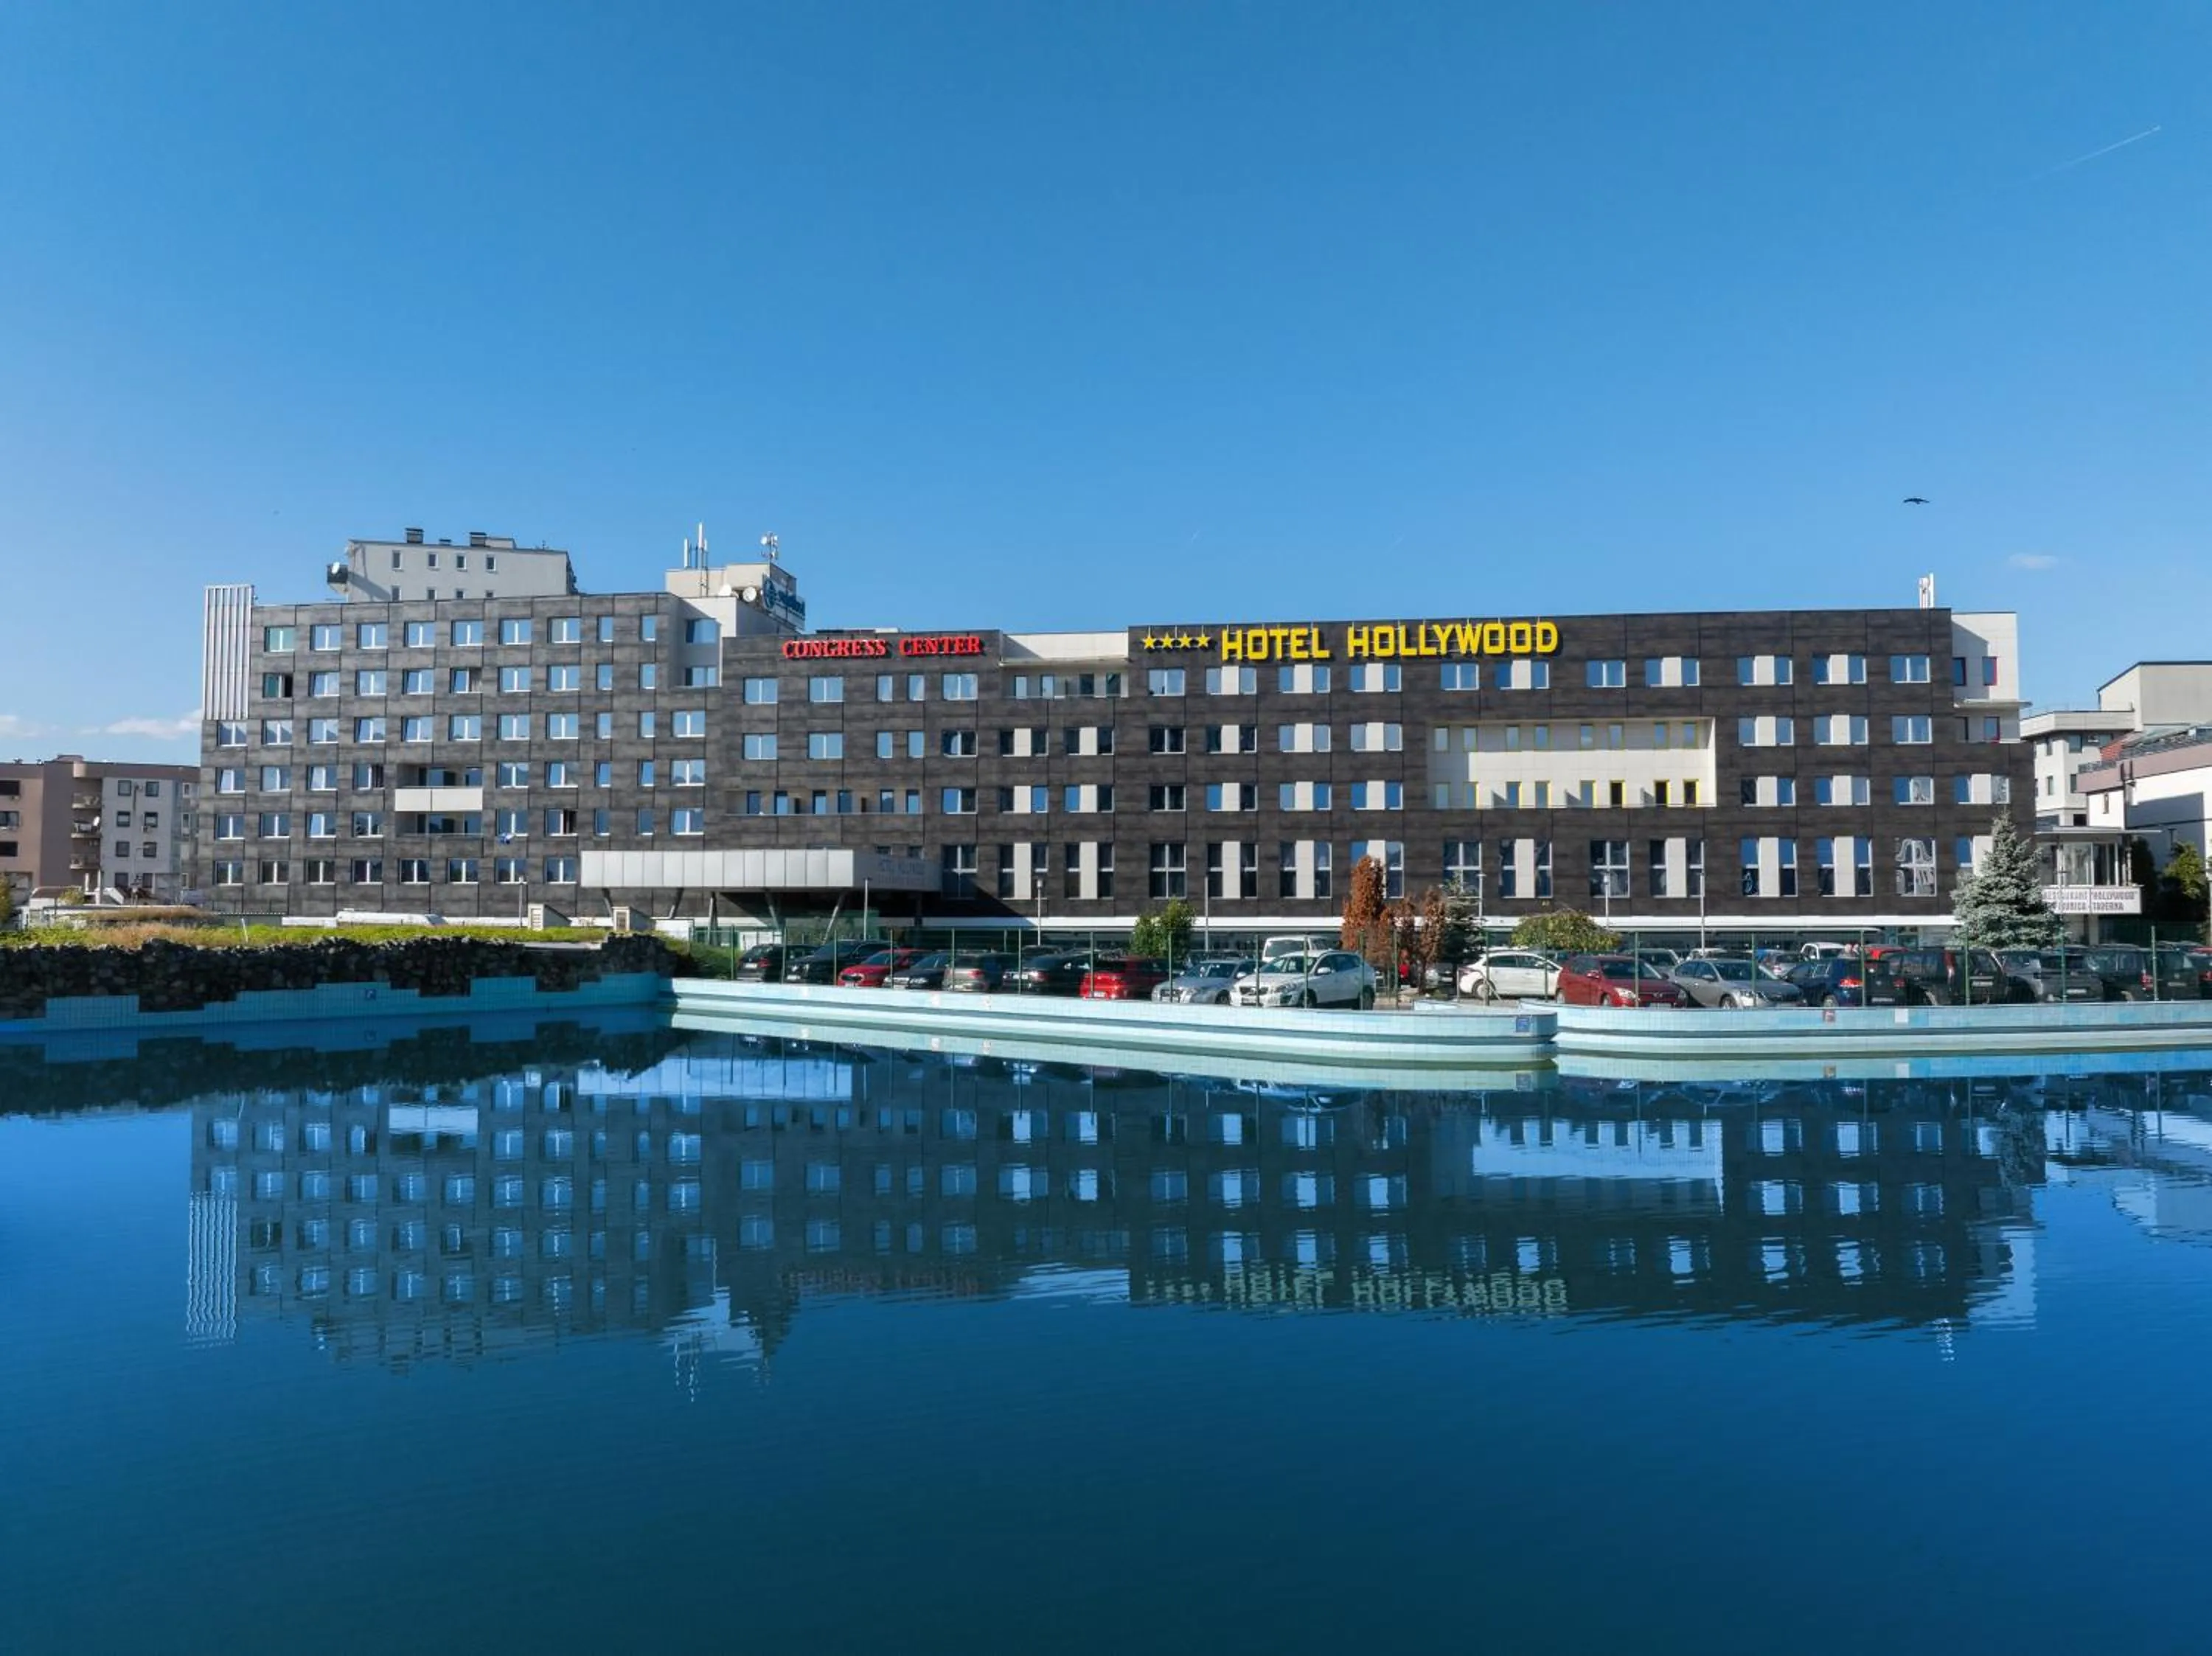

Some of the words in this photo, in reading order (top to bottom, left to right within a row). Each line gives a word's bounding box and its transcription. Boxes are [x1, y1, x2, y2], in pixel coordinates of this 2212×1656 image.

[781, 638, 887, 659] CONGRESS
[898, 634, 981, 656] CENTER
[1221, 627, 1330, 661] HOTEL
[1347, 621, 1558, 658] HOLLYWOOD
